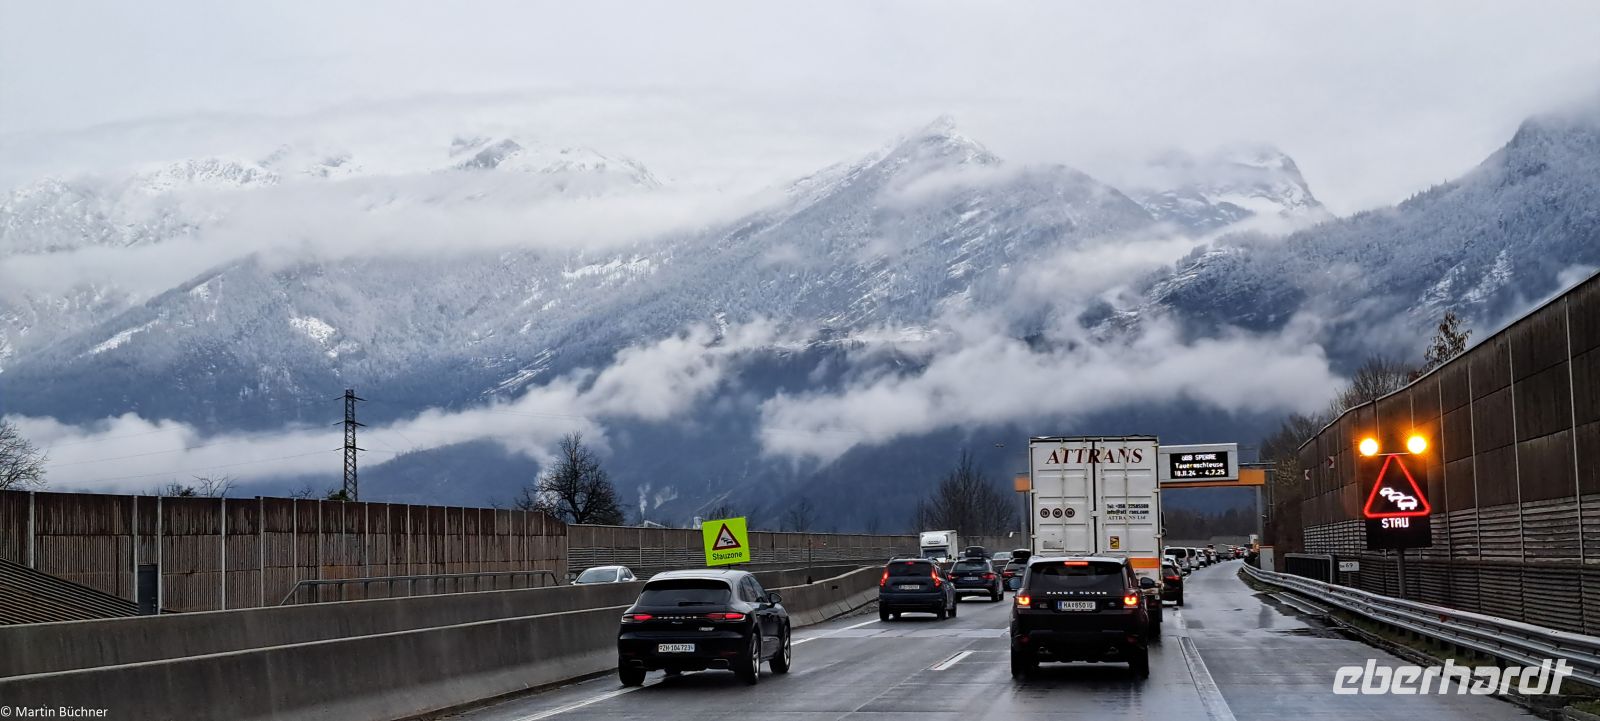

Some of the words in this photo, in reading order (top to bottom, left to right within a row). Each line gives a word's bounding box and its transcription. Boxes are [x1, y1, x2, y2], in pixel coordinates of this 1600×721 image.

[1046, 448, 1143, 465] ATTRANS
[1195, 453, 1217, 461] SPERRE
[1381, 518, 1409, 528] STAU
[712, 552, 743, 561] Stauzone
